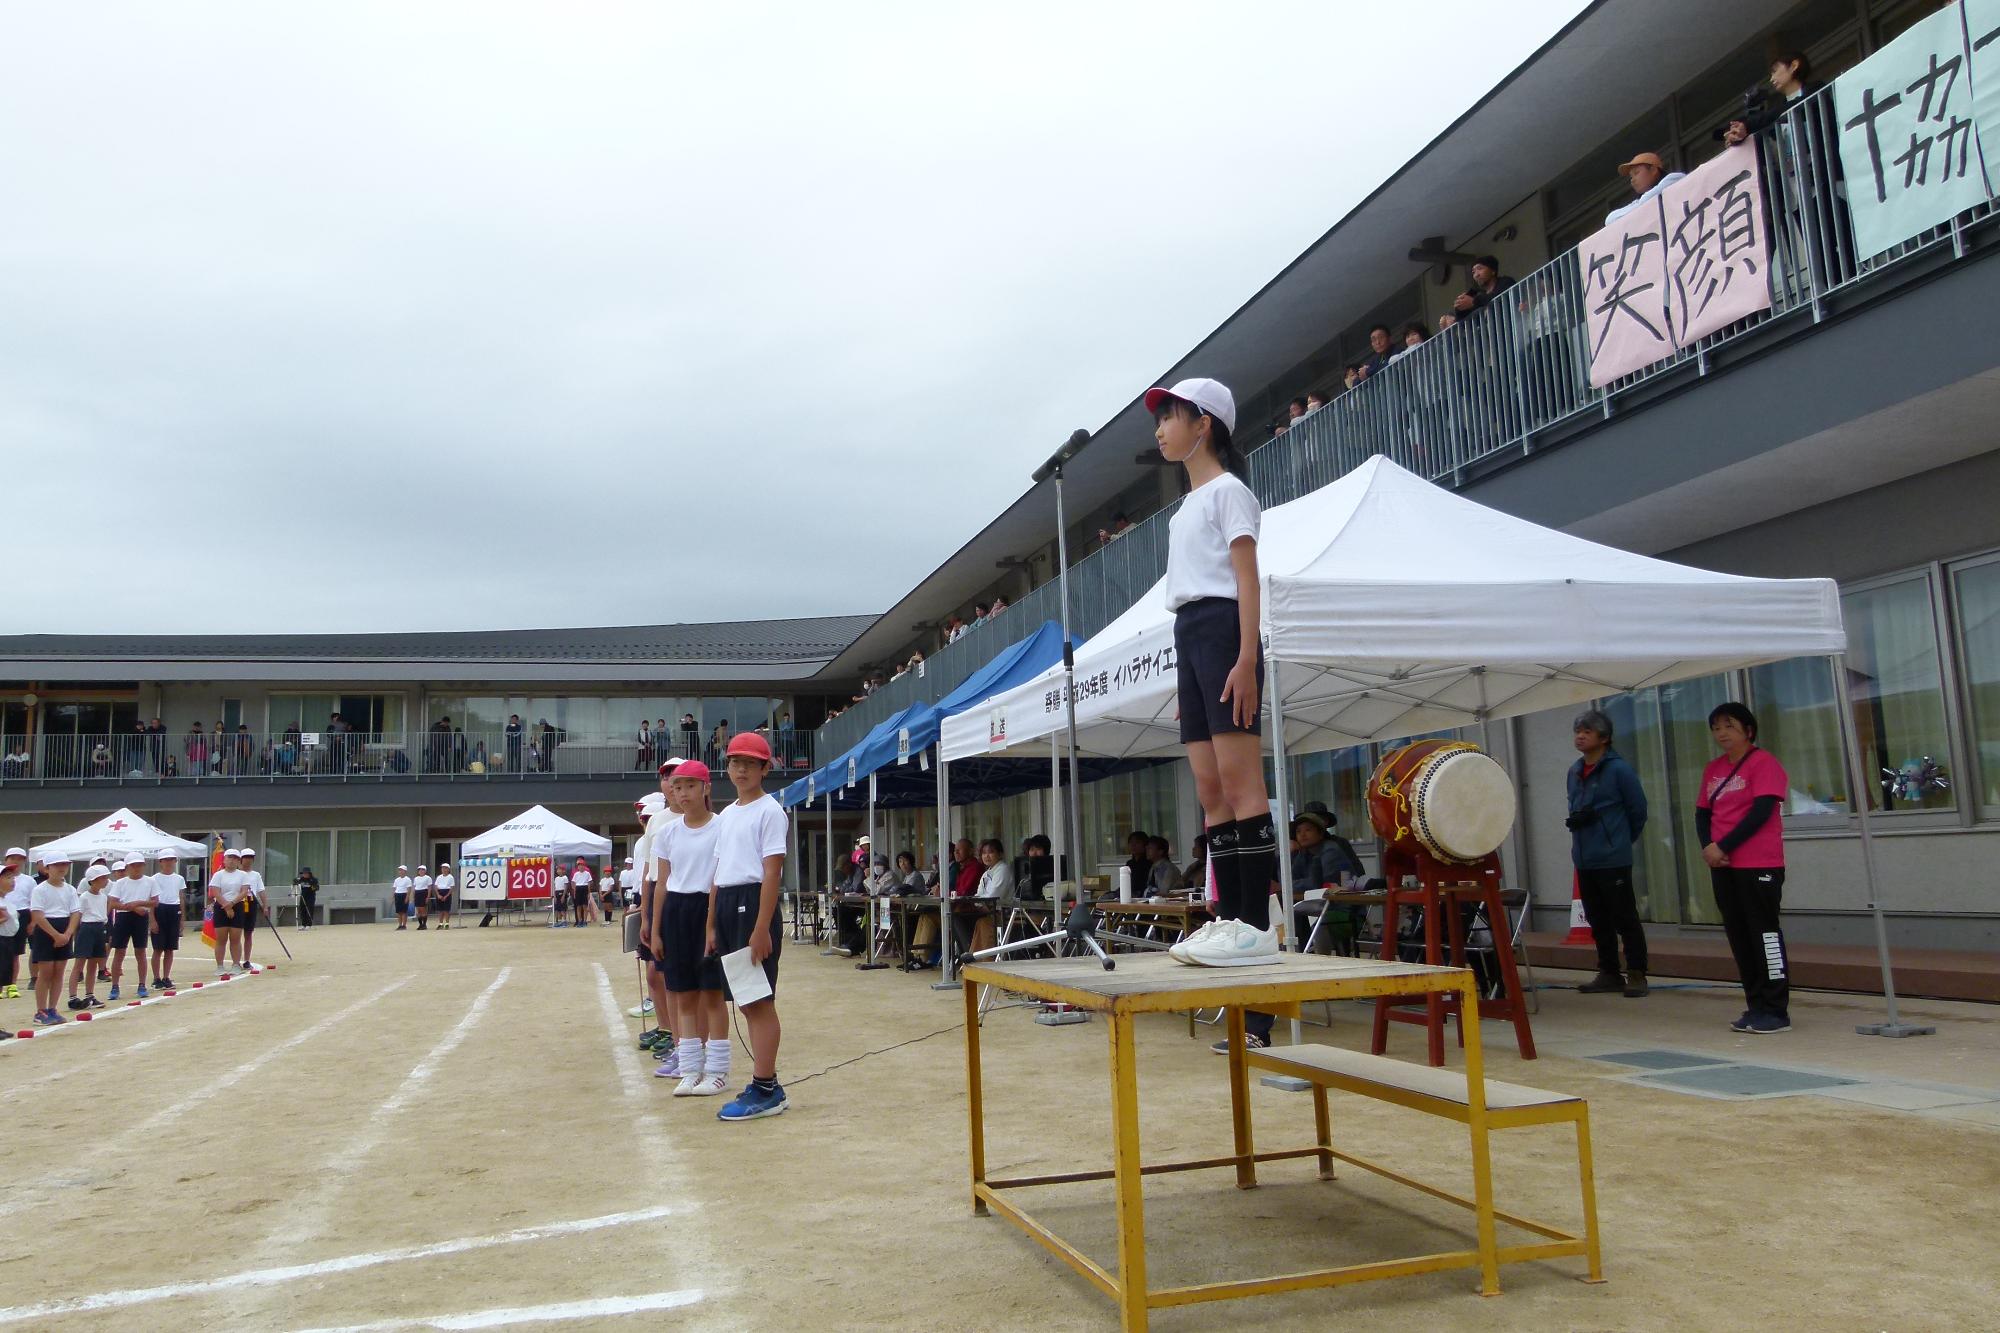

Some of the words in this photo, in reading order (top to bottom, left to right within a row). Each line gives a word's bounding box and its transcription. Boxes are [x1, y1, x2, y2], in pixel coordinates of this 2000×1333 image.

[1845, 27, 2000, 203] 協
[1586, 169, 1757, 364] 笑顔
[1113, 646, 1178, 691] イハラサイエ
[466, 870, 501, 889] 290
[512, 868, 548, 889] 260
[1762, 932, 1785, 980] PUMA
